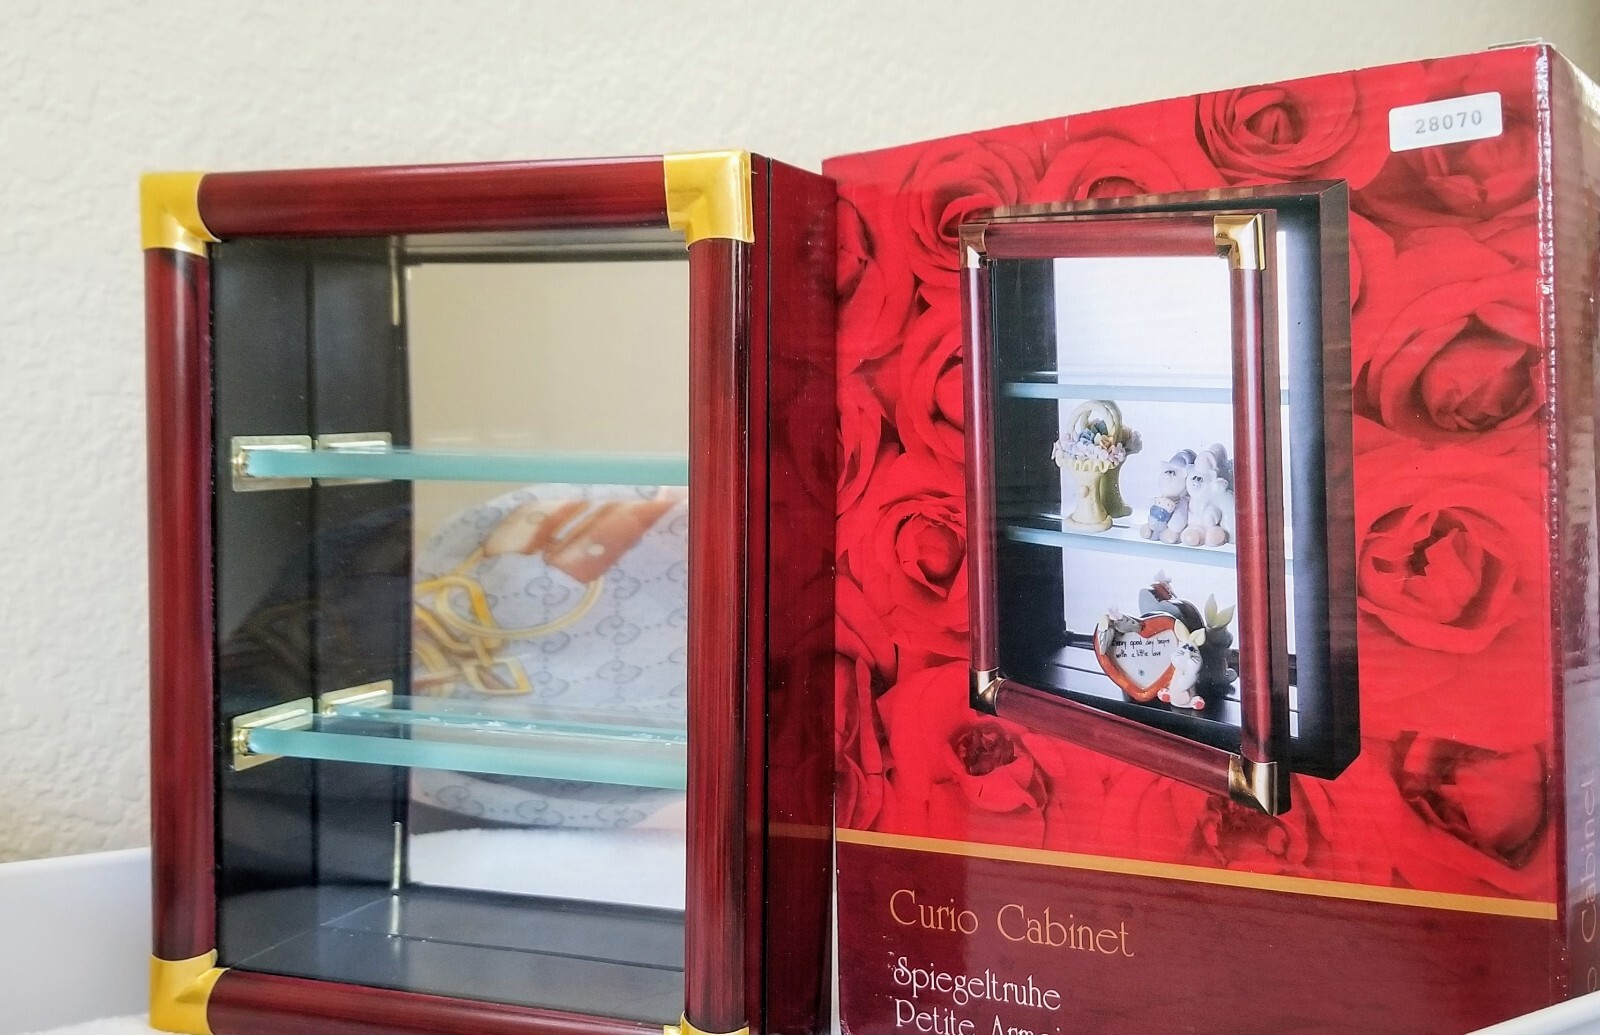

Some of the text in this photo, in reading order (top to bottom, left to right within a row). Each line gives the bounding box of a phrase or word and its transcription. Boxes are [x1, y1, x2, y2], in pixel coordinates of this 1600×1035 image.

[1415, 110, 1482, 134] 28070
[1580, 769, 1597, 943] Cabinet
[889, 889, 1135, 957] Curio Cabinet
[893, 956, 1062, 1010] Spiegeltruhe
[895, 998, 975, 1035] Petite
